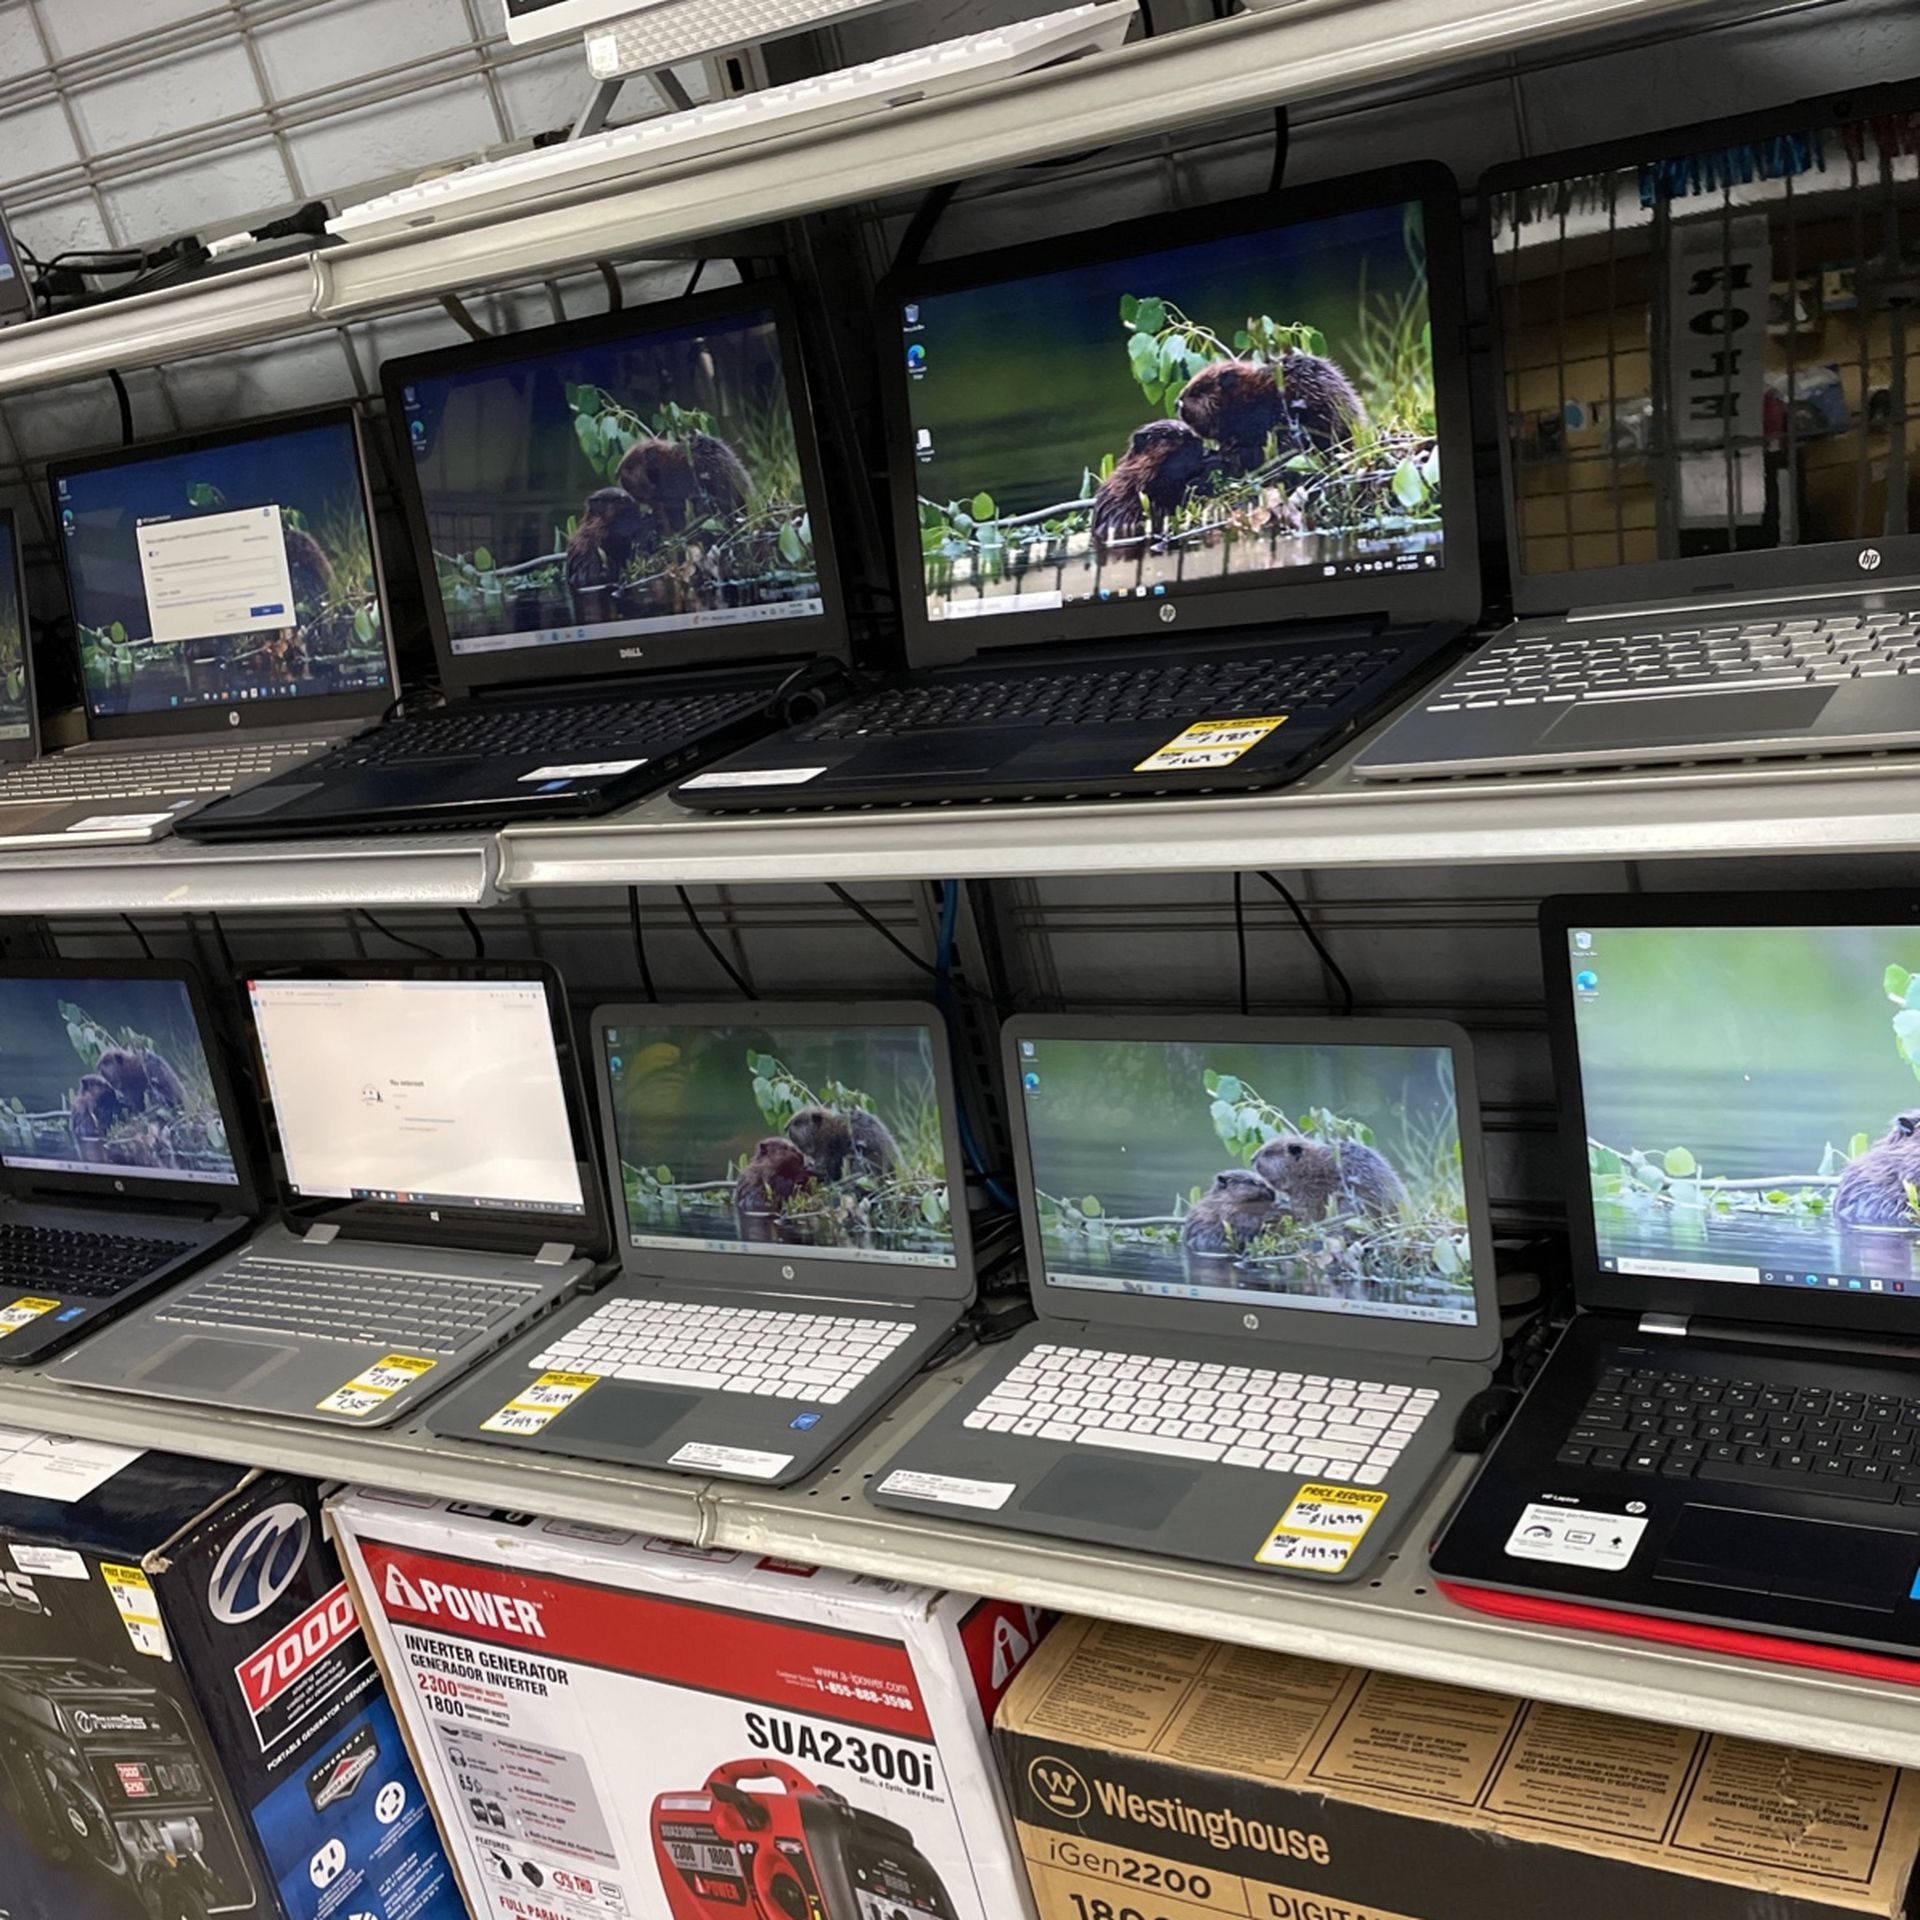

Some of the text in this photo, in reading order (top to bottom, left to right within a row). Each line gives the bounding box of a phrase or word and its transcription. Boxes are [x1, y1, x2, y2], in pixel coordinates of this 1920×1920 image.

[1858, 548, 1881, 570] hp
[620, 647, 643, 658] DELL
[1302, 1486, 1383, 1503] PRICE REDUCED
[1553, 1494, 1580, 1504] Laptop
[1296, 1502, 1322, 1511] WAS
[1625, 1501, 1647, 1514] hp
[1274, 1535, 1300, 1544] NOW
[250, 1592, 354, 1698] 7000
[405, 1634, 569, 1686] INVERTER GENERATOR
[410, 1653, 549, 1697] GENERADOR INVERTER
[417, 1673, 458, 1697] 2300
[425, 1695, 464, 1717] 1800
[267, 1739, 302, 1771] PORTABLE
[302, 1705, 340, 1742] GENERATOR
[312, 1743, 352, 1781] POWERED
[744, 1712, 935, 1791] SUA2300i
[459, 1774, 473, 1793] 6.5
[1617, 1766, 1670, 1781] RETOURNER
[1093, 1778, 1330, 1865] Westinghouse
[1050, 1839, 1211, 1899] iGen2200
[499, 1896, 526, 1914] FULL
